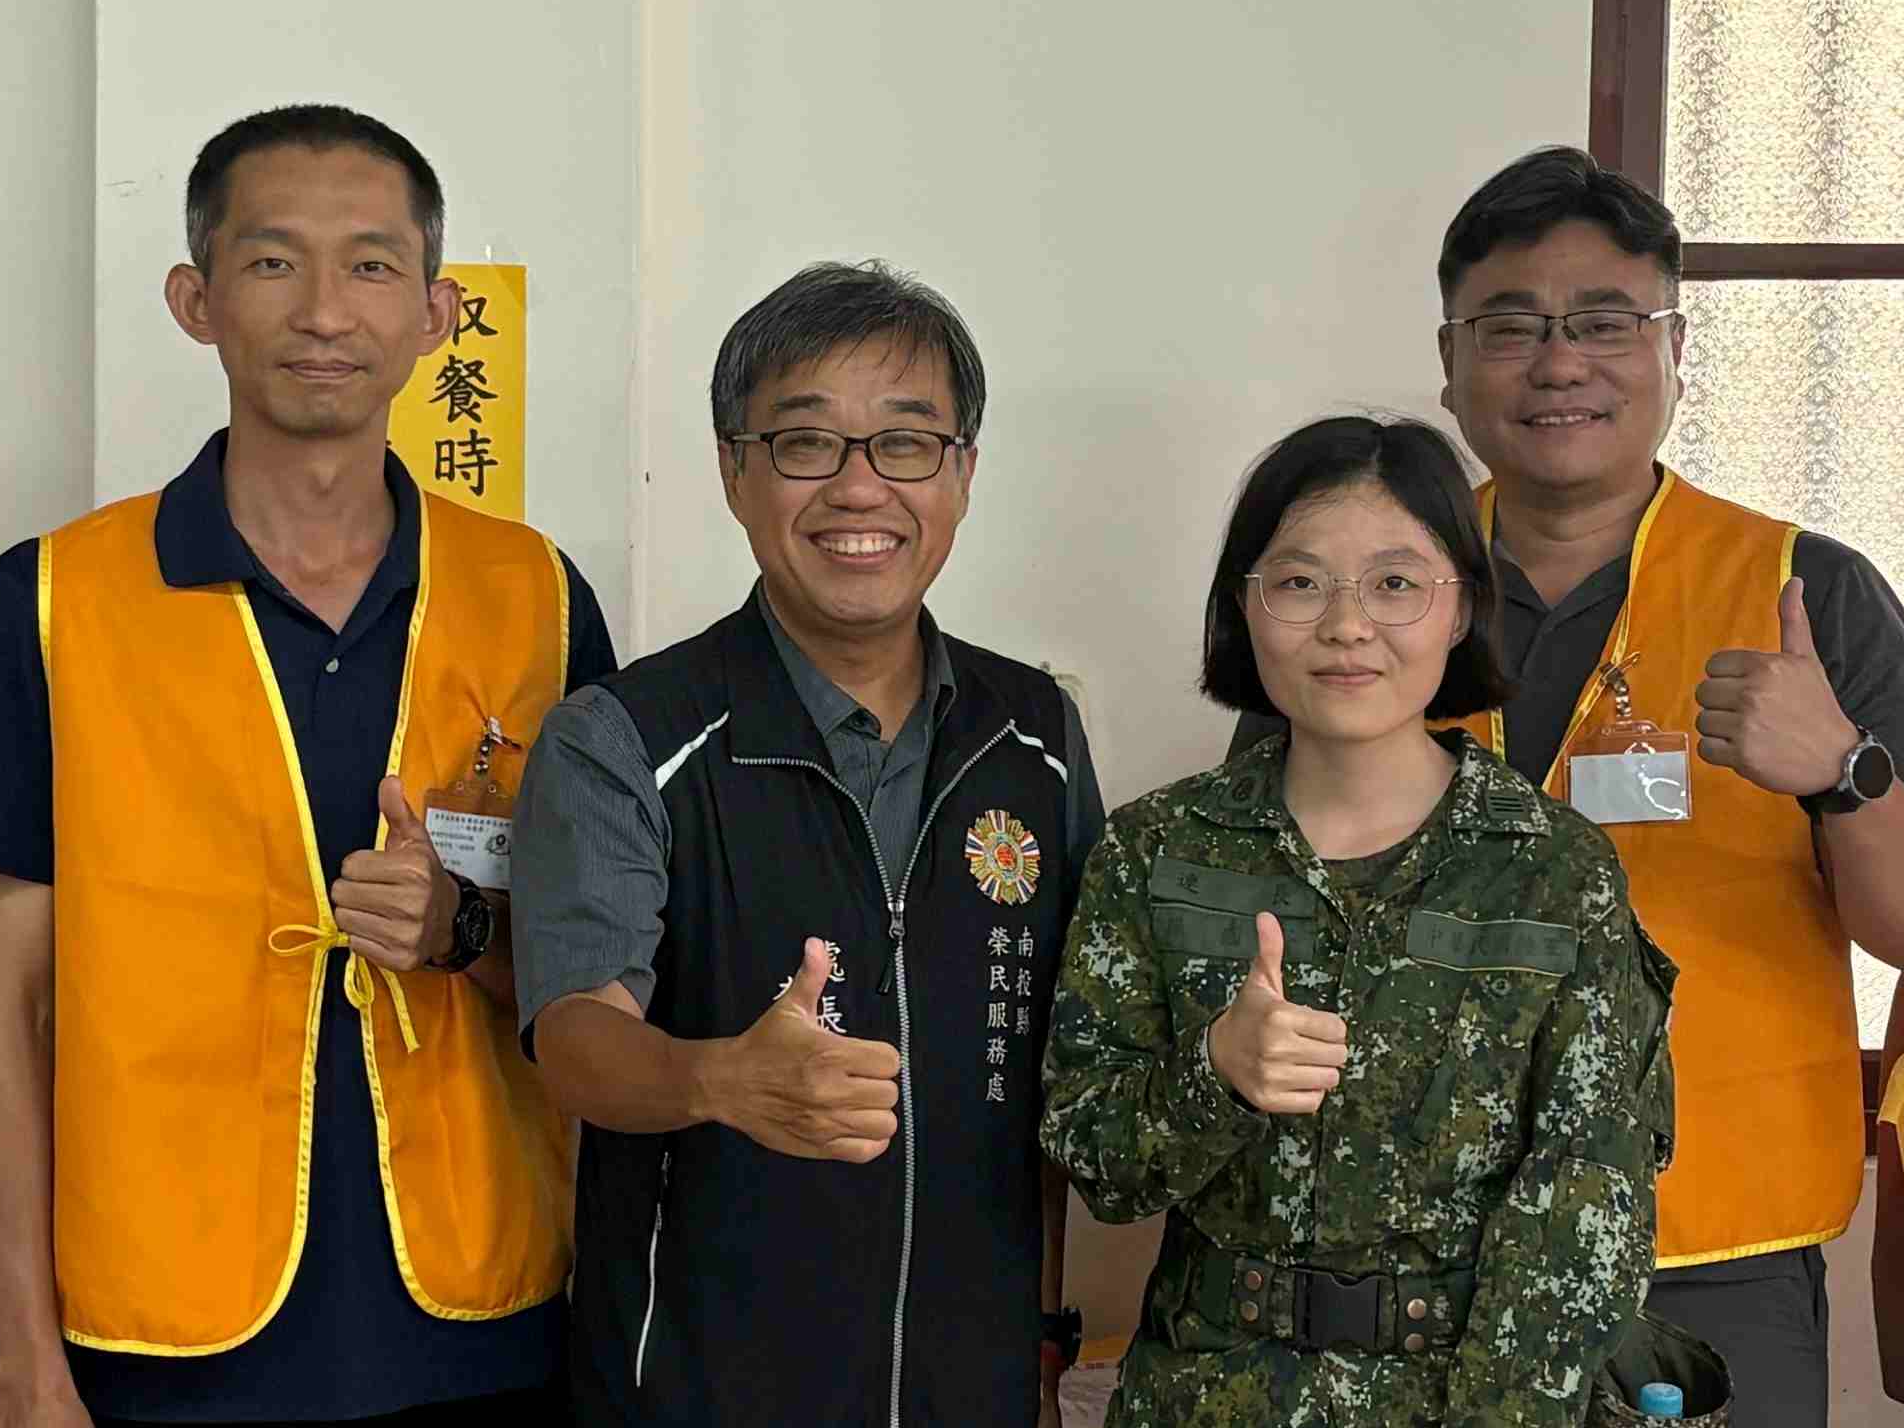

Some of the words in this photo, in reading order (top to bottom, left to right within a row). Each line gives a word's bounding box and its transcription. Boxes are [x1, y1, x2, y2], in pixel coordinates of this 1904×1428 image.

[985, 925, 1012, 1103] 榮民服務處
[1014, 925, 1034, 1037] 南投縣
